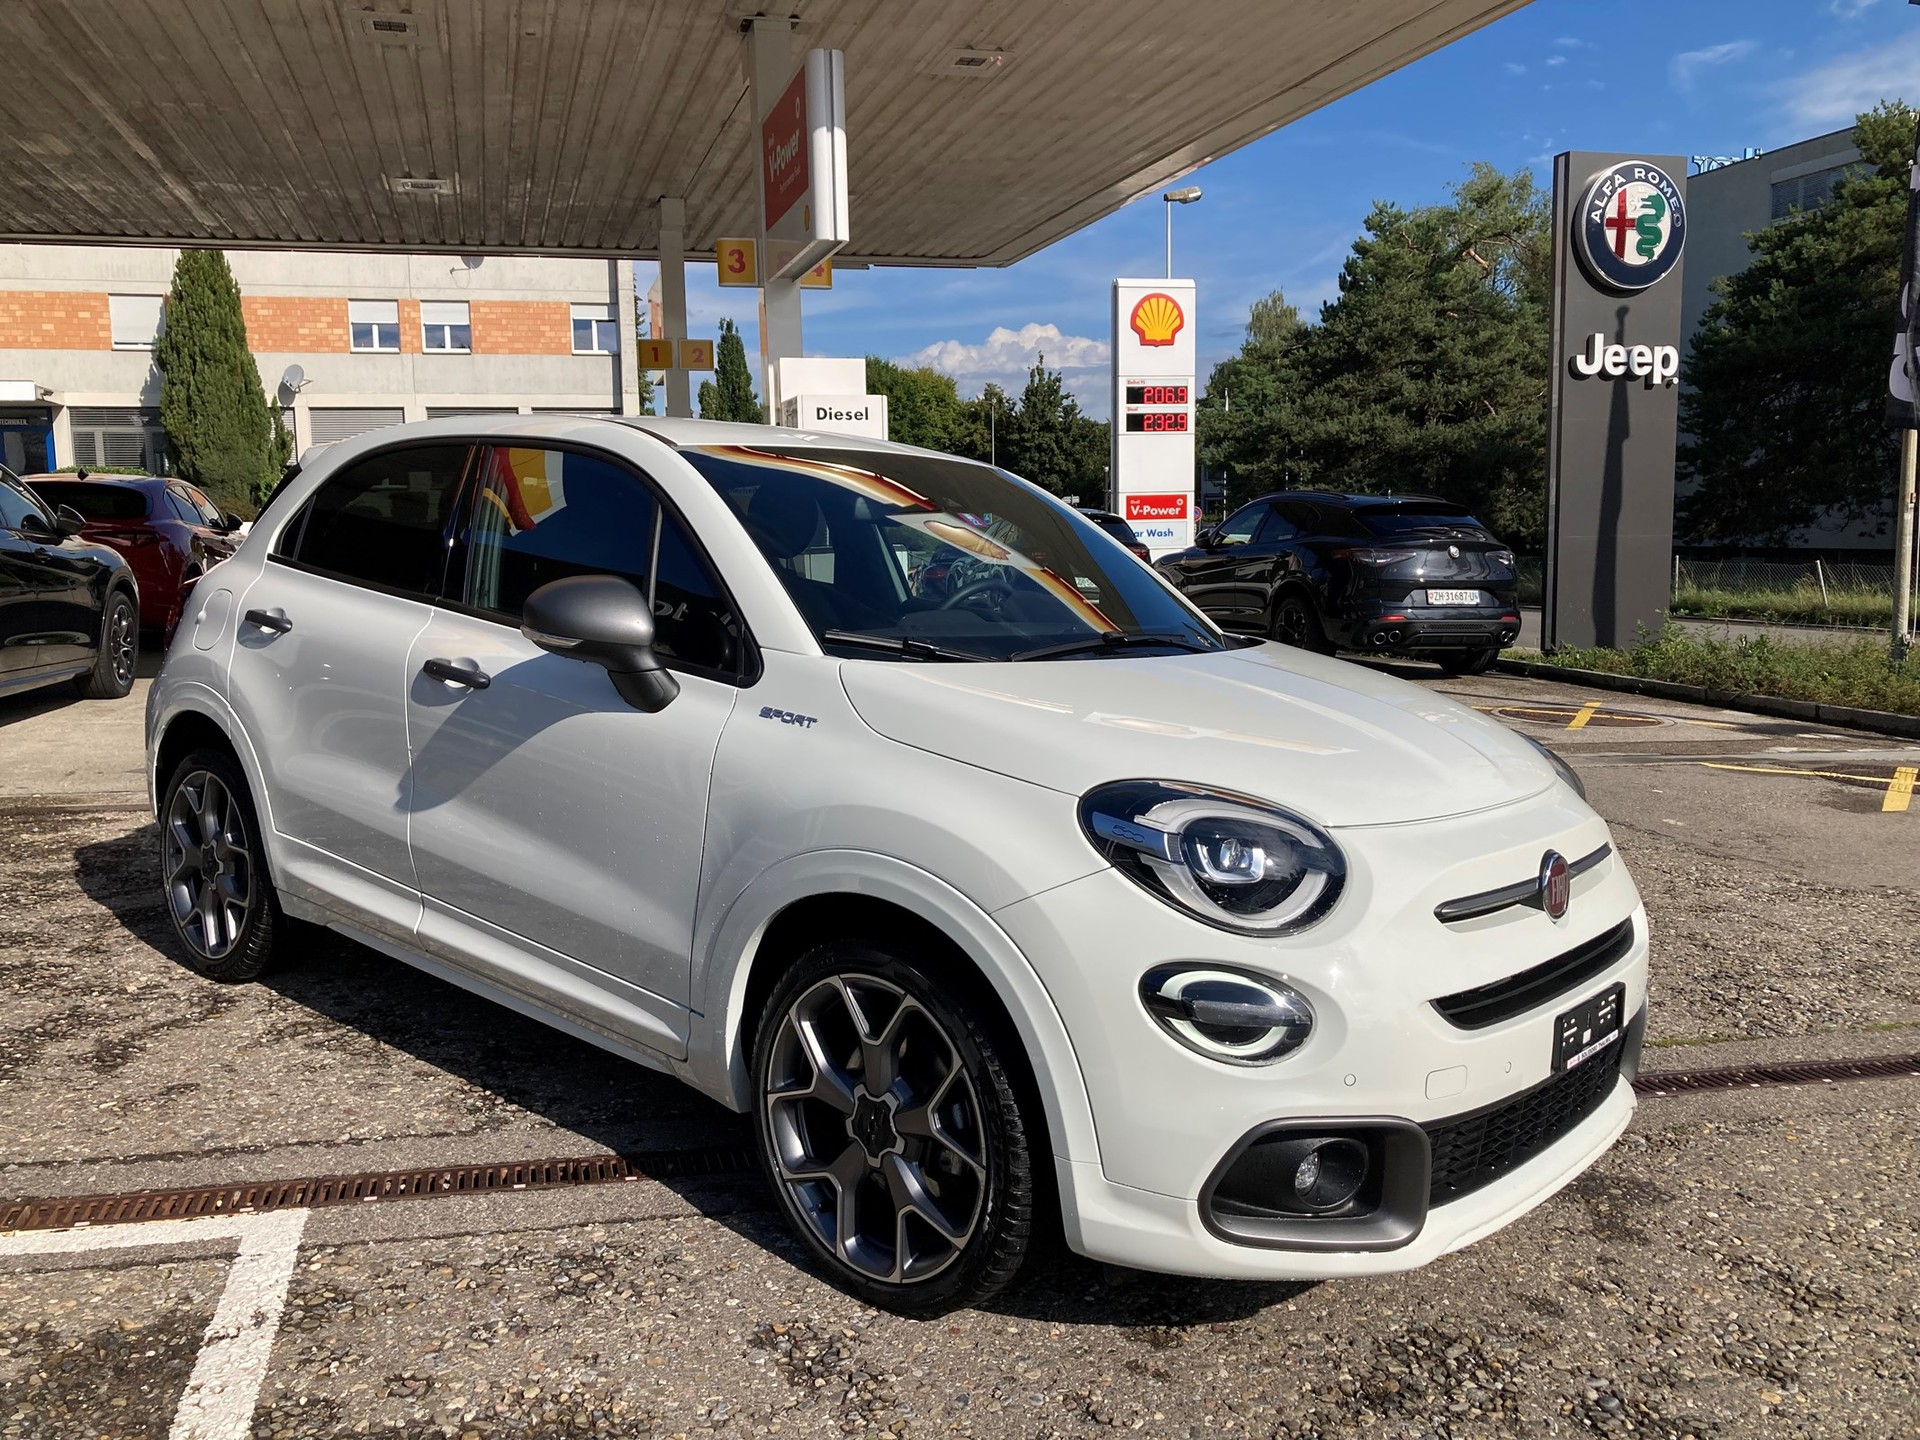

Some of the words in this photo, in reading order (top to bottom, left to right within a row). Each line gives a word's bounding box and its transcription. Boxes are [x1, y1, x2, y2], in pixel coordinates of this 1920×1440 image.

[1590, 173, 1627, 224] ALFA
[1634, 167, 1683, 228] ROMEO
[727, 248, 746, 274] 3
[651, 346, 659, 363] 1
[692, 347, 705, 363] 2
[1576, 333, 1680, 385] Jeep
[1143, 386, 1188, 404] 206.9
[816, 406, 869, 421] Diesel
[1143, 413, 1188, 432] 232.9
[1130, 505, 1182, 516] V-Power
[1146, 528, 1174, 538] Wash
[759, 706, 819, 729] SPORT
[1551, 872, 1568, 906] FIAT
